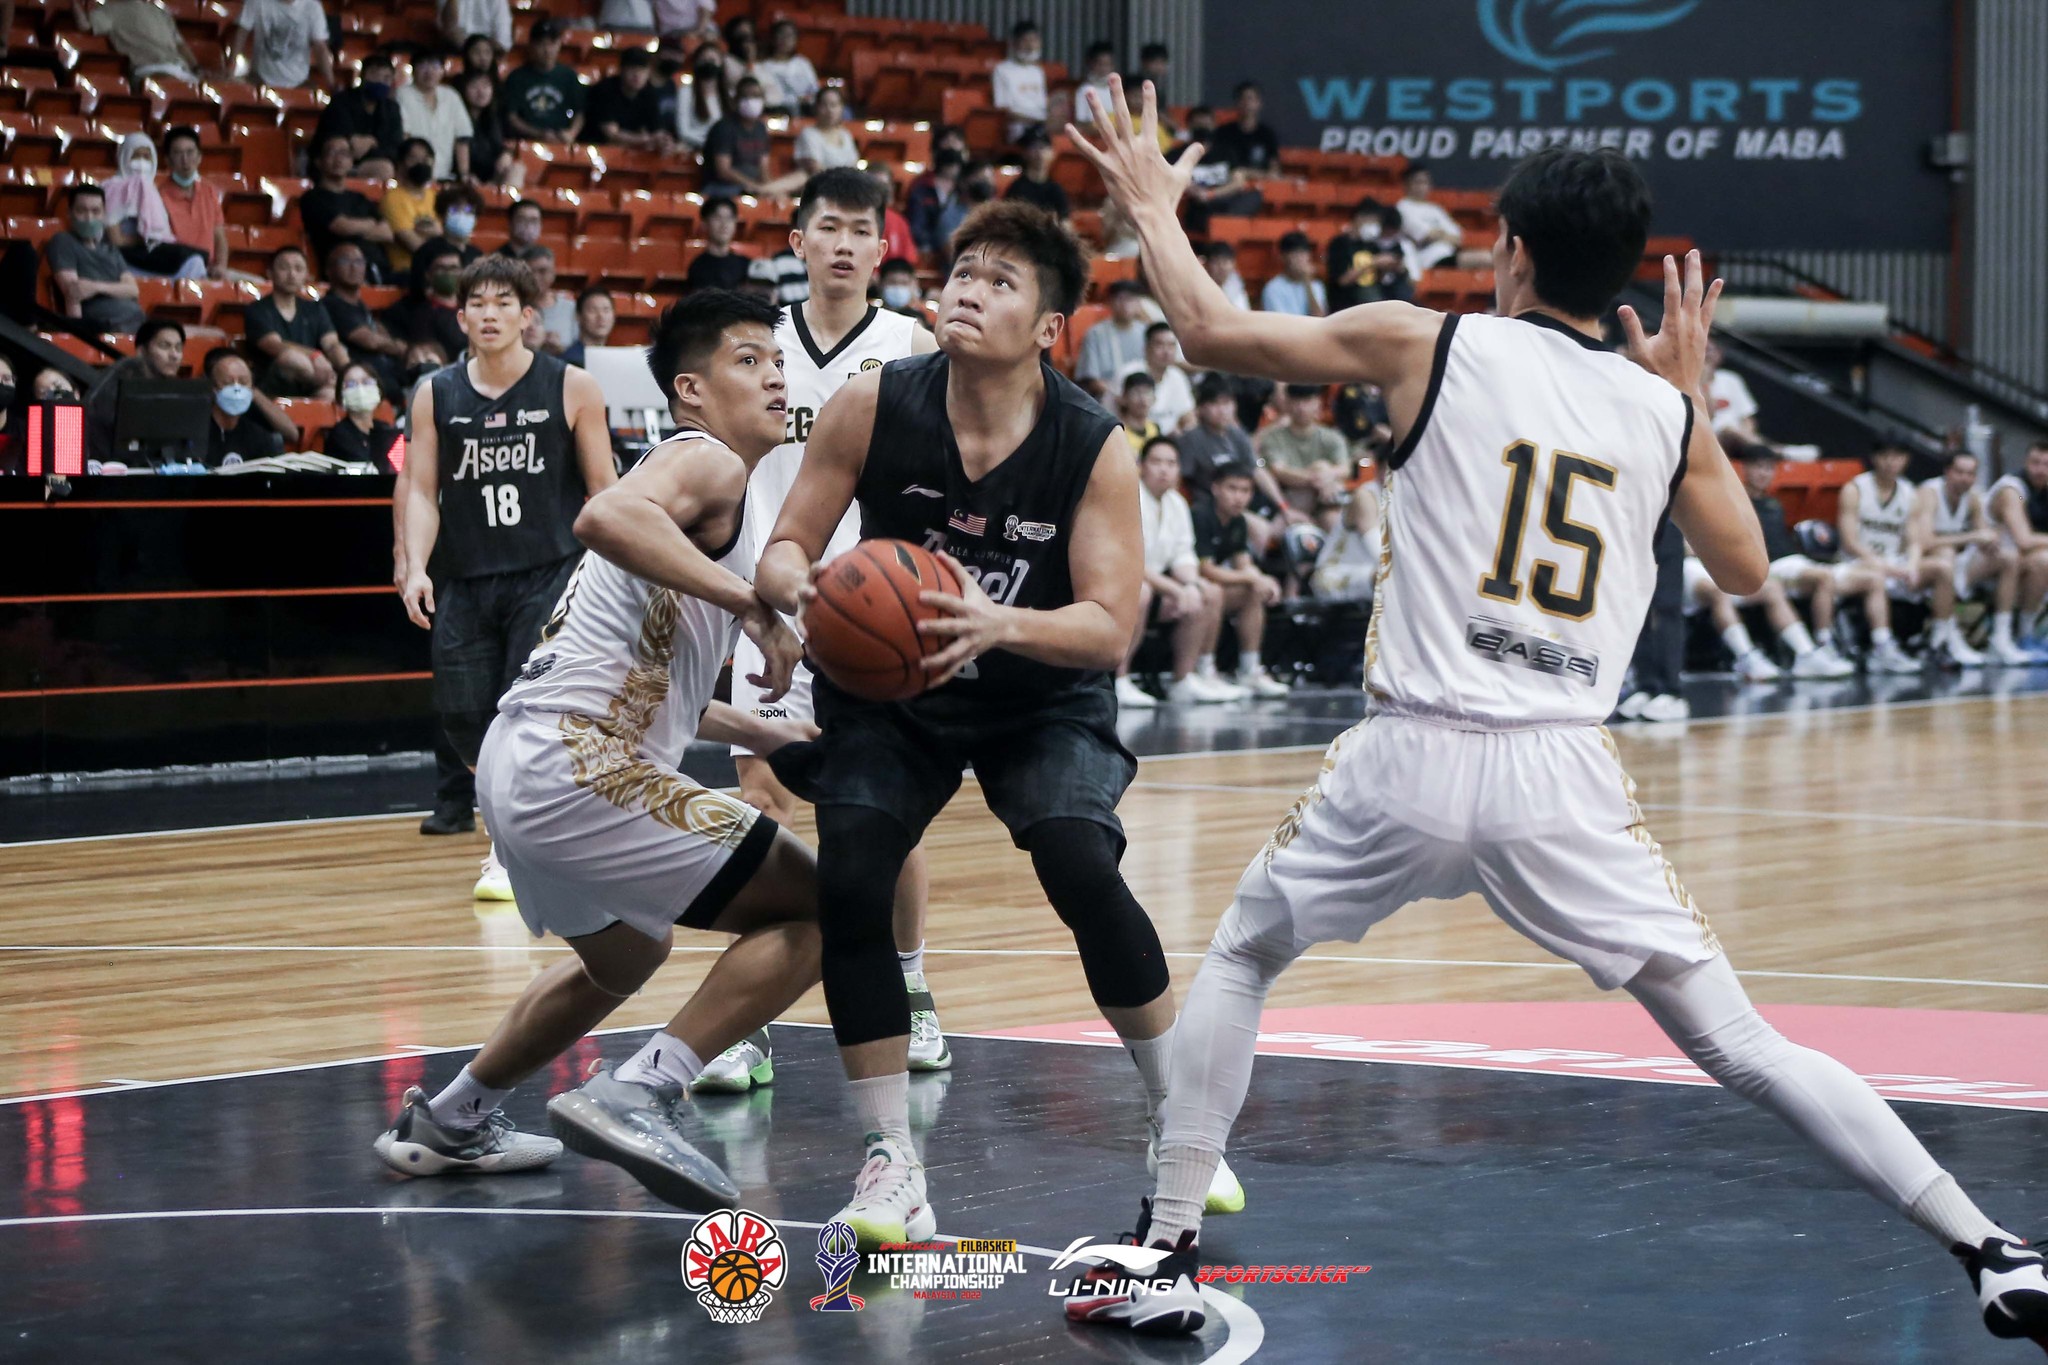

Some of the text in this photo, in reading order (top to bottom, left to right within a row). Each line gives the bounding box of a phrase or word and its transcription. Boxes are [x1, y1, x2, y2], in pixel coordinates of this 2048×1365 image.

[1299, 78, 1862, 122] WESTPORTS
[1320, 126, 1845, 160] PROUD PARTNER OF MABA
[481, 483, 522, 527] 18
[1477, 438, 1619, 622] 15
